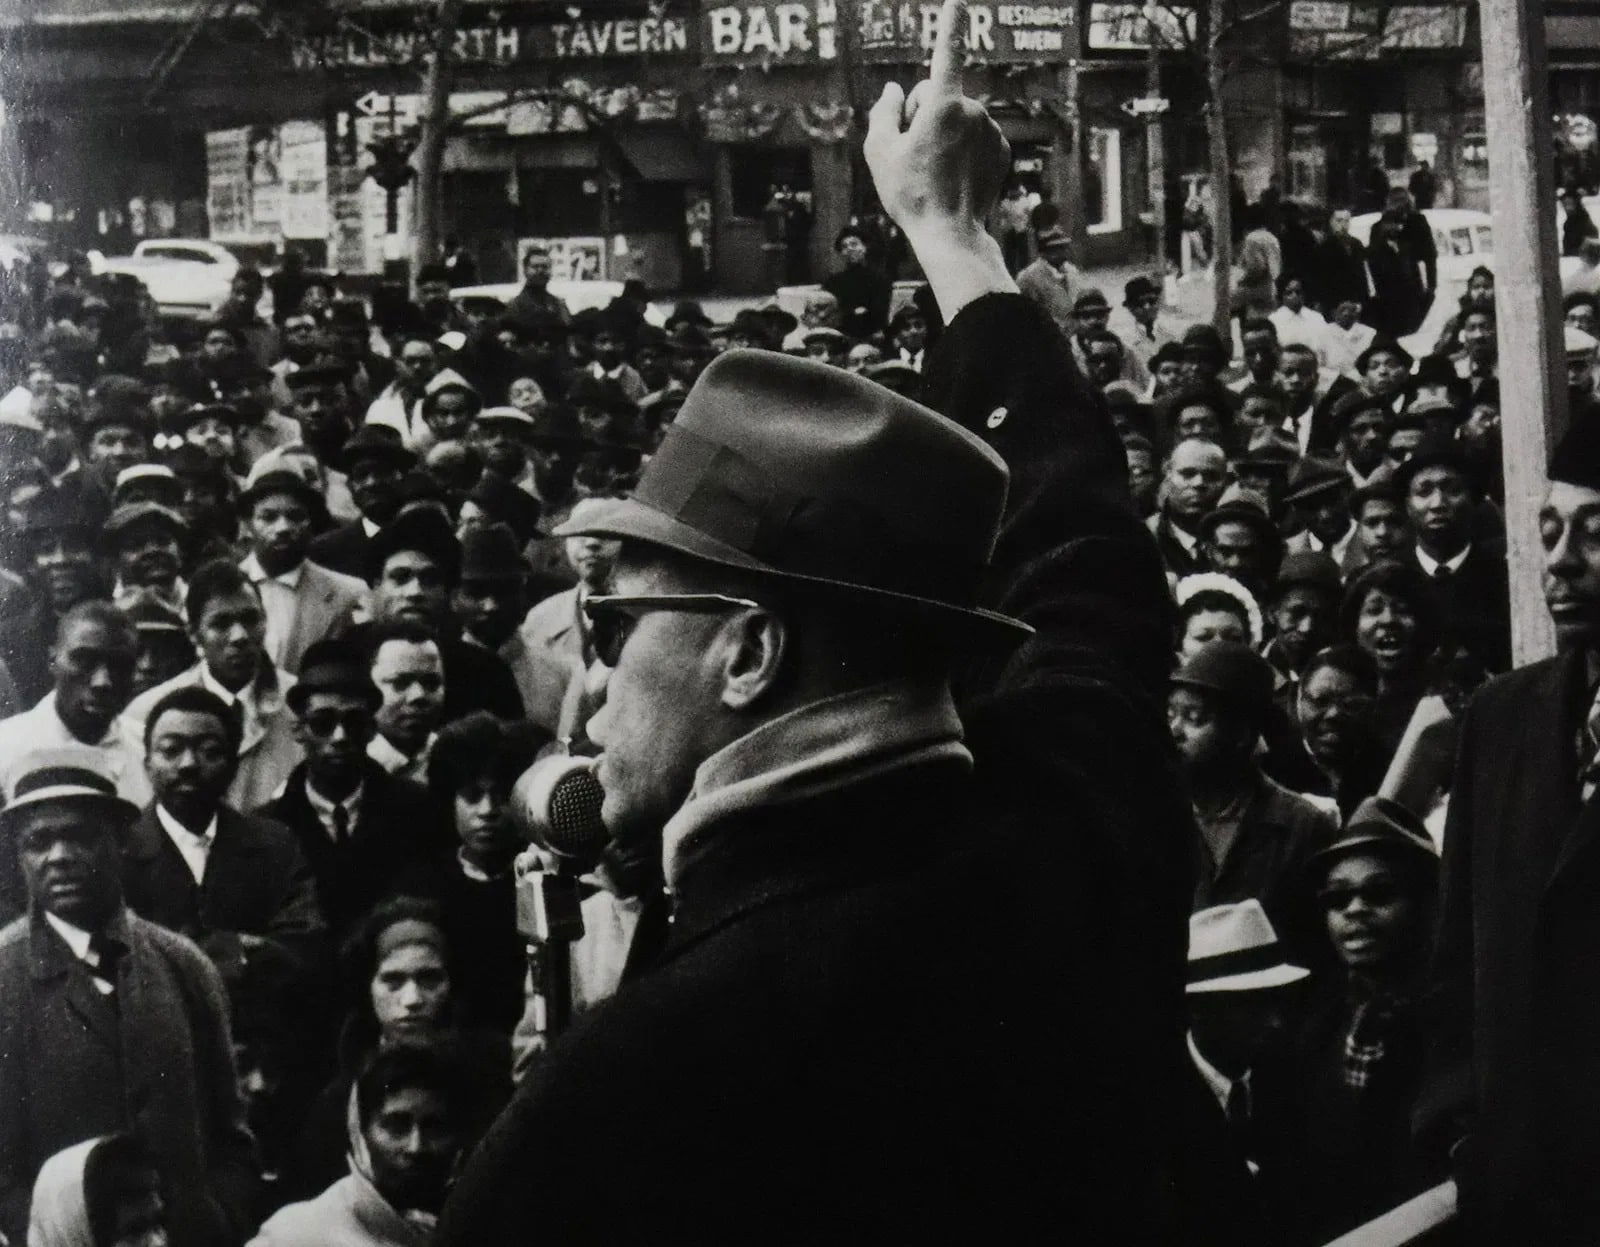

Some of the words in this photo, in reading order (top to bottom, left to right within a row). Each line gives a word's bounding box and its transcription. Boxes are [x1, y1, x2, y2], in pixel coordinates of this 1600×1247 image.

[552, 18, 688, 56] TAVERN
[708, 3, 813, 54] BAR
[919, 4, 995, 51] BR
